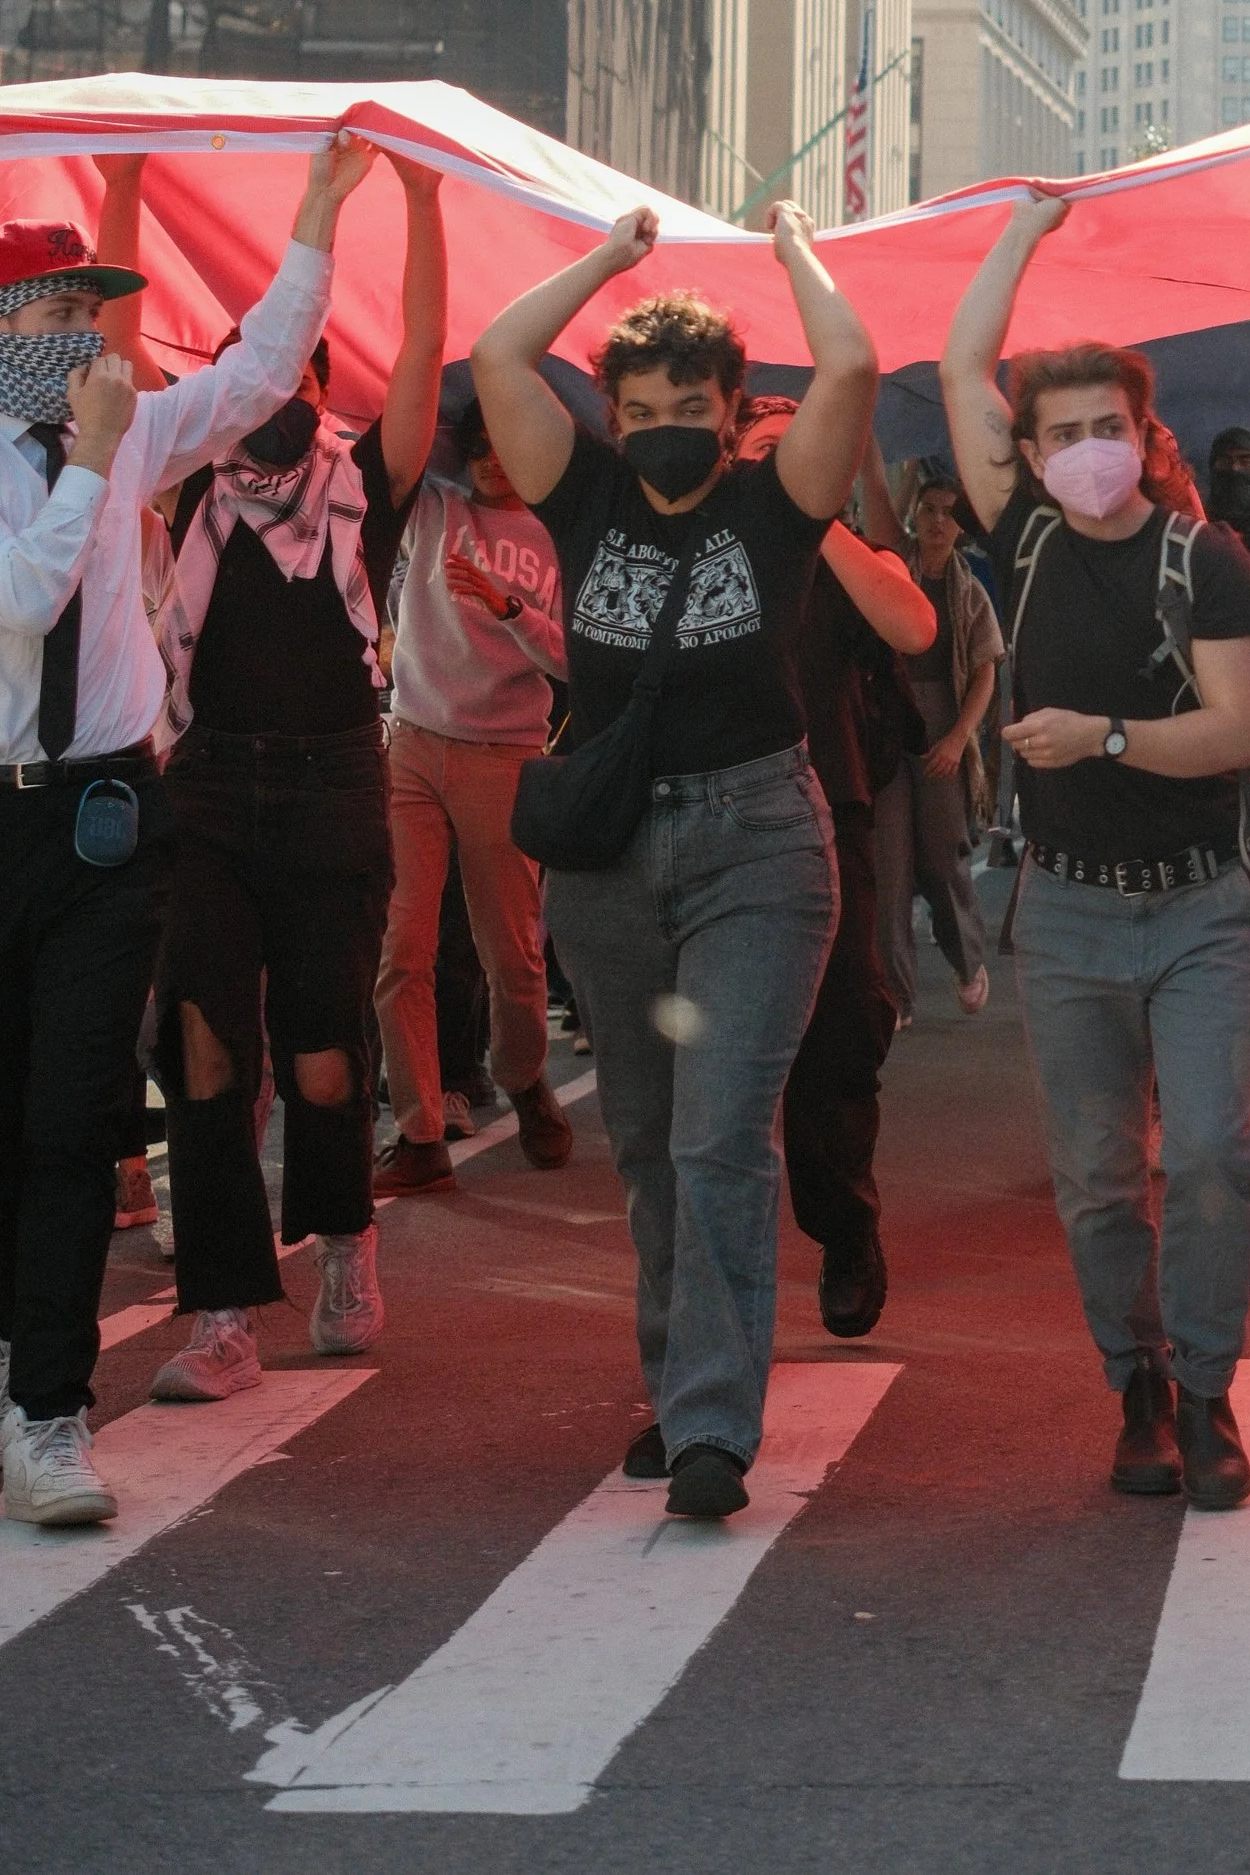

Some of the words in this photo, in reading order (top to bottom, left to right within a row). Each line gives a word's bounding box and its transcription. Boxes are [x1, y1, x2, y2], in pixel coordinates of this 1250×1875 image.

[705, 528, 736, 553] ALL
[584, 625, 651, 650] COMPROMI
[680, 635, 698, 649] NO
[703, 617, 761, 645] APOLOGY
